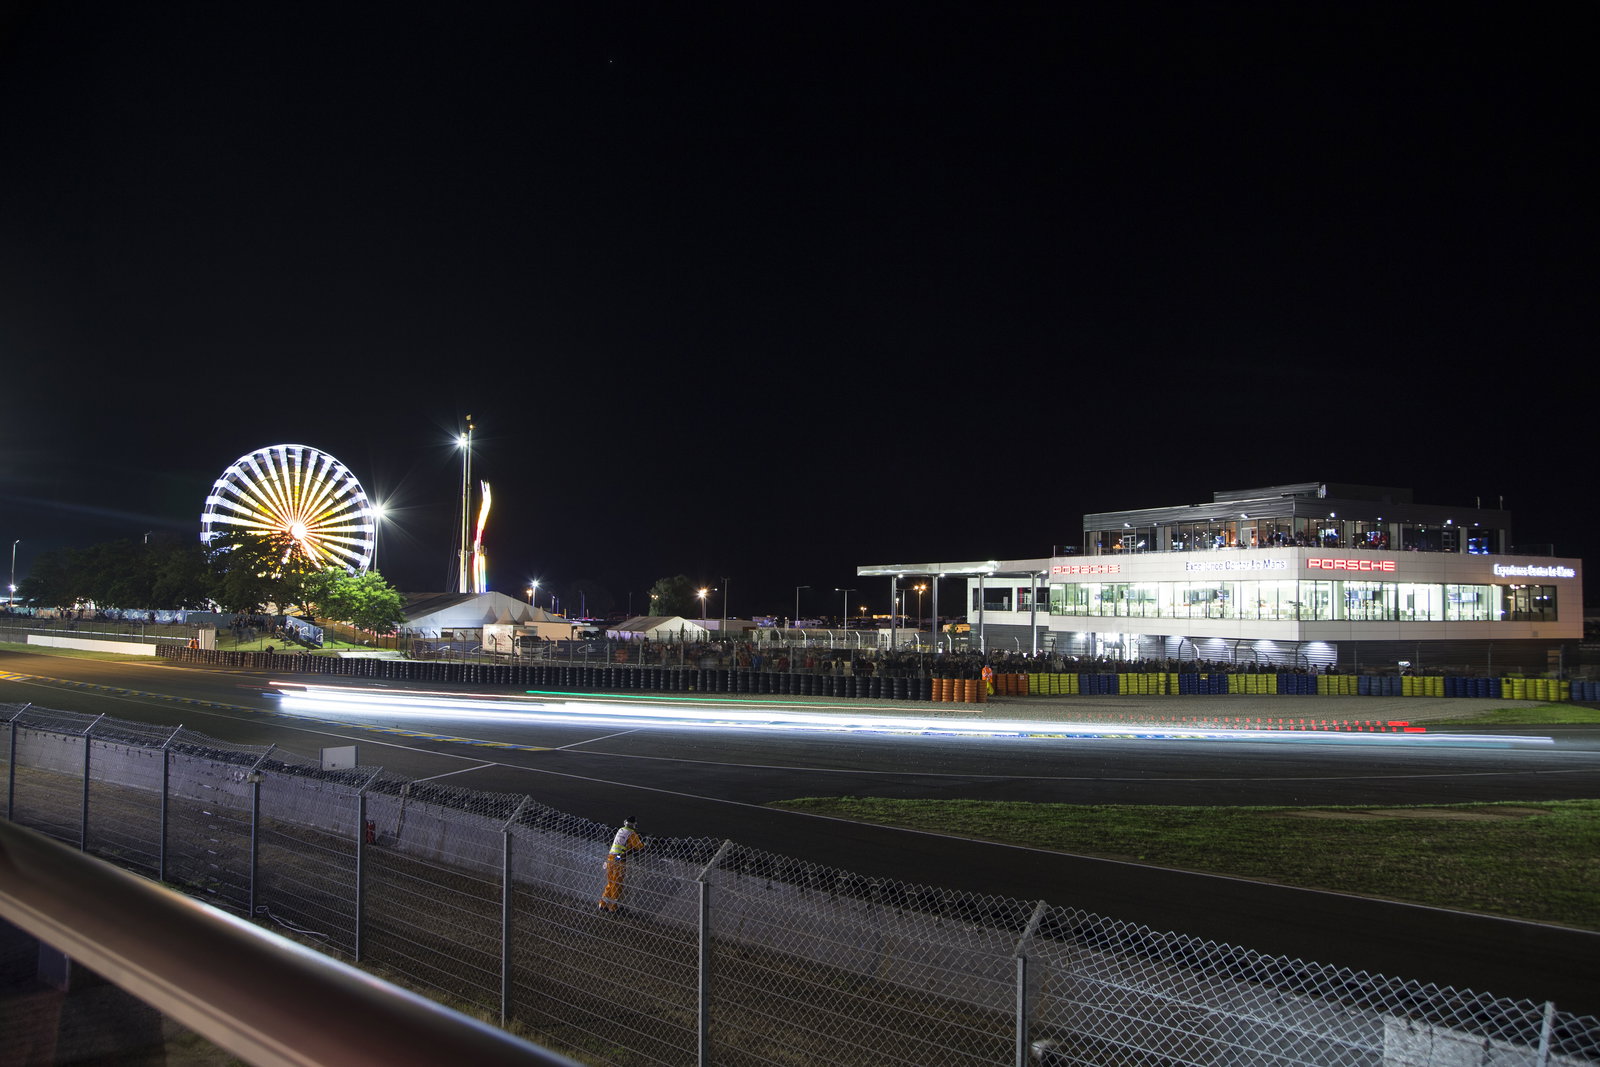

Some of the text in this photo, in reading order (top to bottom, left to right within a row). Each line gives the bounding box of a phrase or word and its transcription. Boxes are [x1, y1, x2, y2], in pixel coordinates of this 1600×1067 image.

[1052, 564, 1121, 575] PORSCHE
[1262, 558, 1287, 570] Mans
[1307, 558, 1397, 572] PORSCHE
